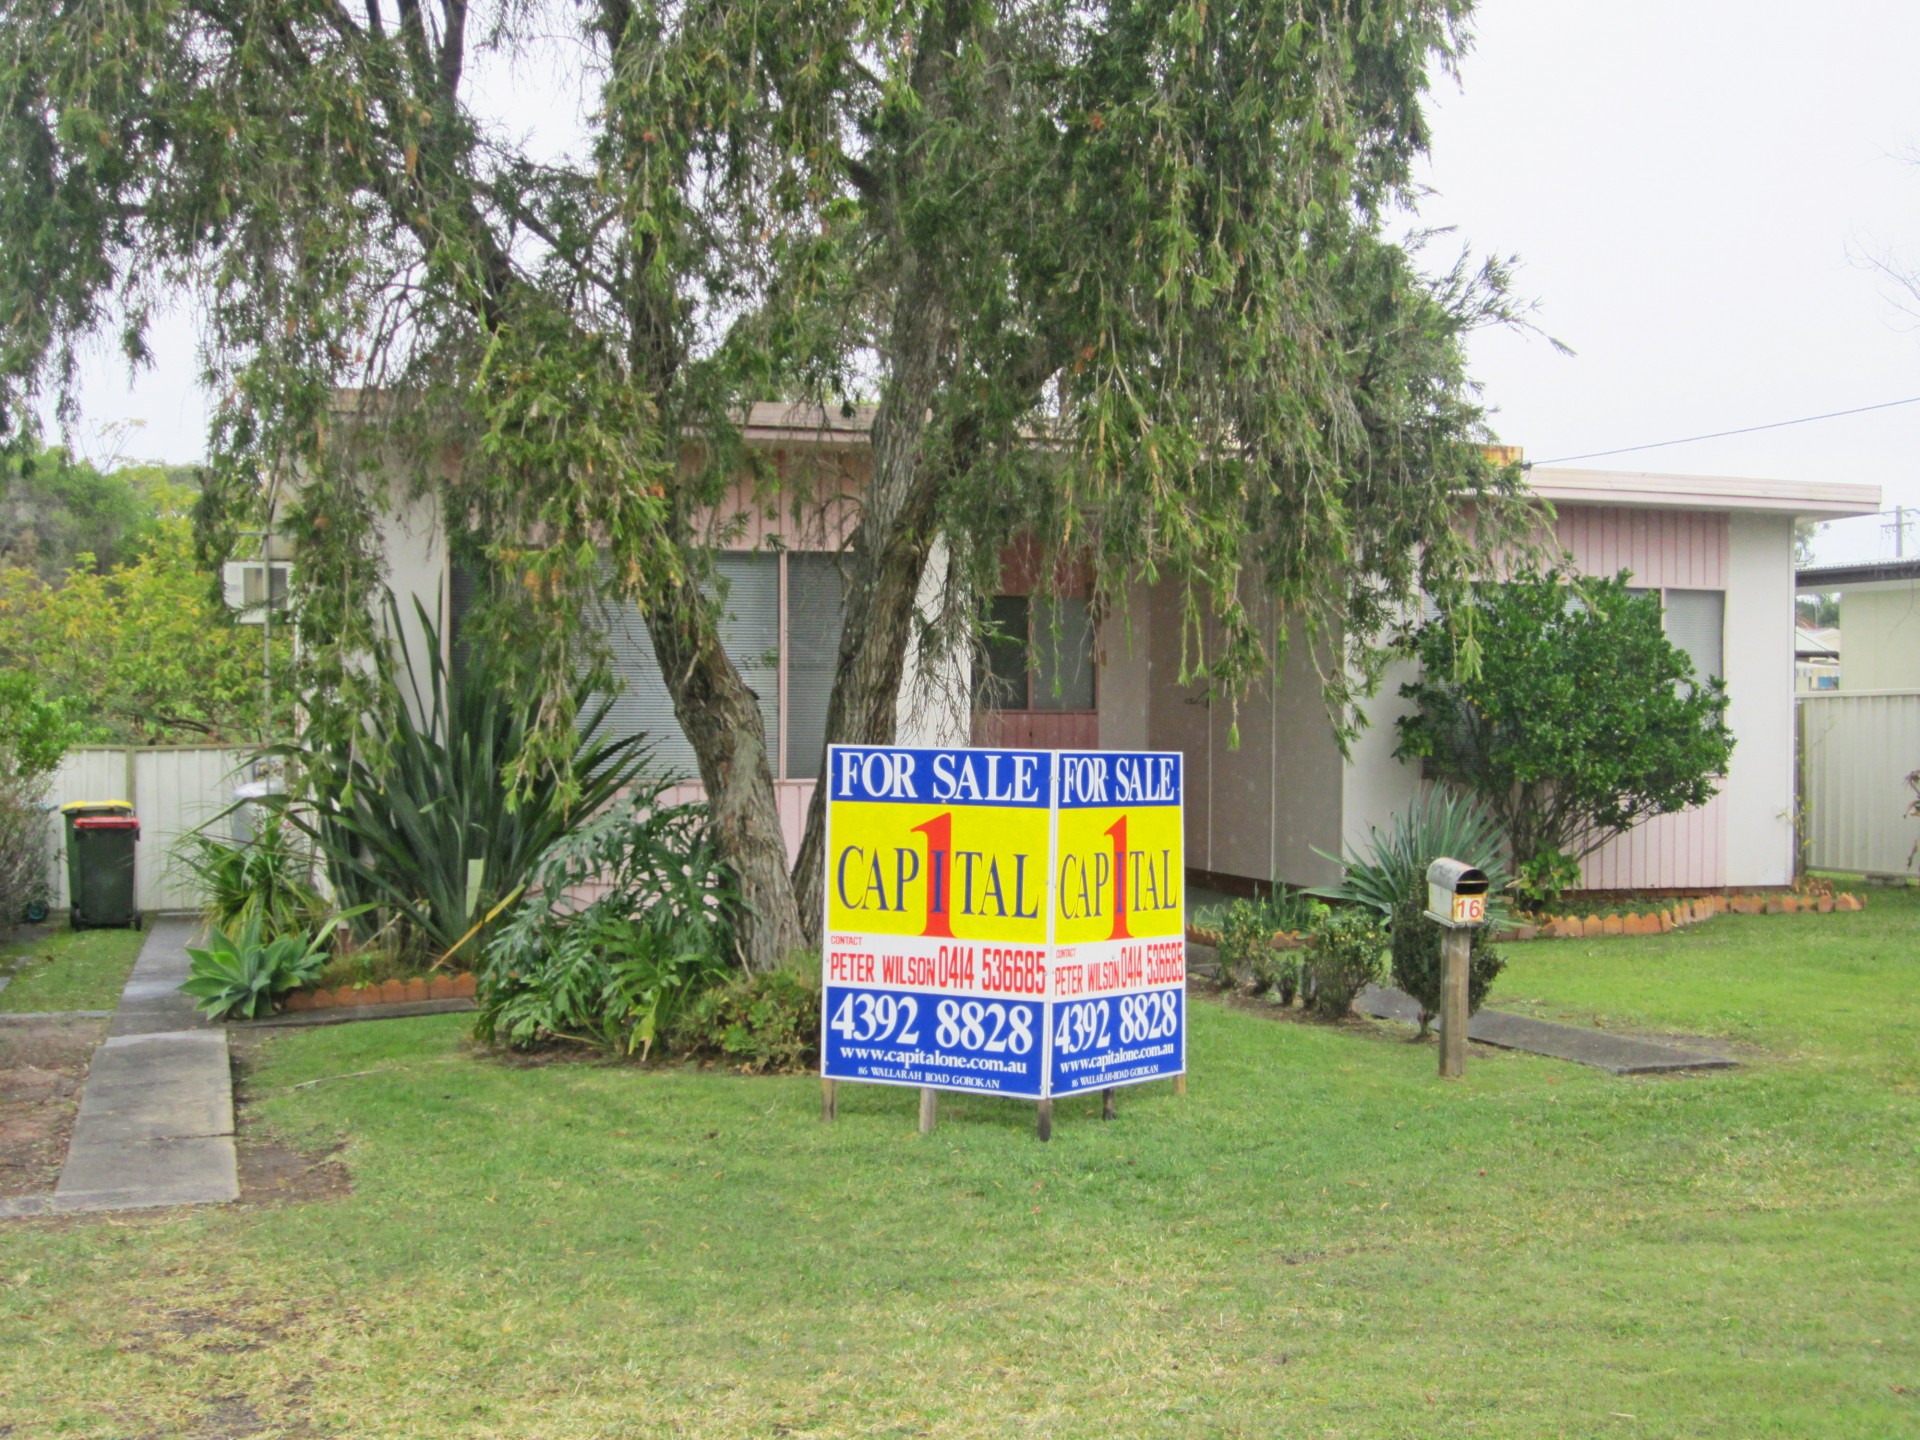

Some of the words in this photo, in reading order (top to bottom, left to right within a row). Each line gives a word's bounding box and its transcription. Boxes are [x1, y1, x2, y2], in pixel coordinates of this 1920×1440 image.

[839, 752, 918, 798] FOR
[933, 754, 1039, 802] SALE
[1062, 757, 1108, 803] FOR
[1115, 757, 1175, 801] SALE
[837, 845, 1039, 919] CAPITAL
[1060, 850, 1177, 920] CAPITAL
[1456, 899, 1481, 918] 16
[830, 935, 862, 946] CONTACT
[1056, 948, 1076, 959] CONTACT
[830, 952, 875, 983] PETER
[882, 955, 935, 987] WILSON
[938, 945, 975, 990] 0414
[982, 948, 1046, 995] 536685
[1055, 964, 1083, 996] PETER
[1088, 960, 1120, 993] WILSON
[1121, 945, 1143, 988] 0414
[1147, 941, 1184, 986] 536685
[830, 993, 919, 1045] 4392
[935, 999, 1033, 1055] 8828
[1055, 1000, 1111, 1055] 4392
[1119, 990, 1177, 1044] 8828
[840, 1047, 1027, 1074] www.capitalone.com.au
[858, 1067, 868, 1075] 86
[871, 1067, 922, 1081] WALLARAH
[925, 1072, 950, 1084] ROAD
[952, 1076, 1000, 1089] GOROKAN
[1060, 1043, 1174, 1074] www.capitalone.com.au
